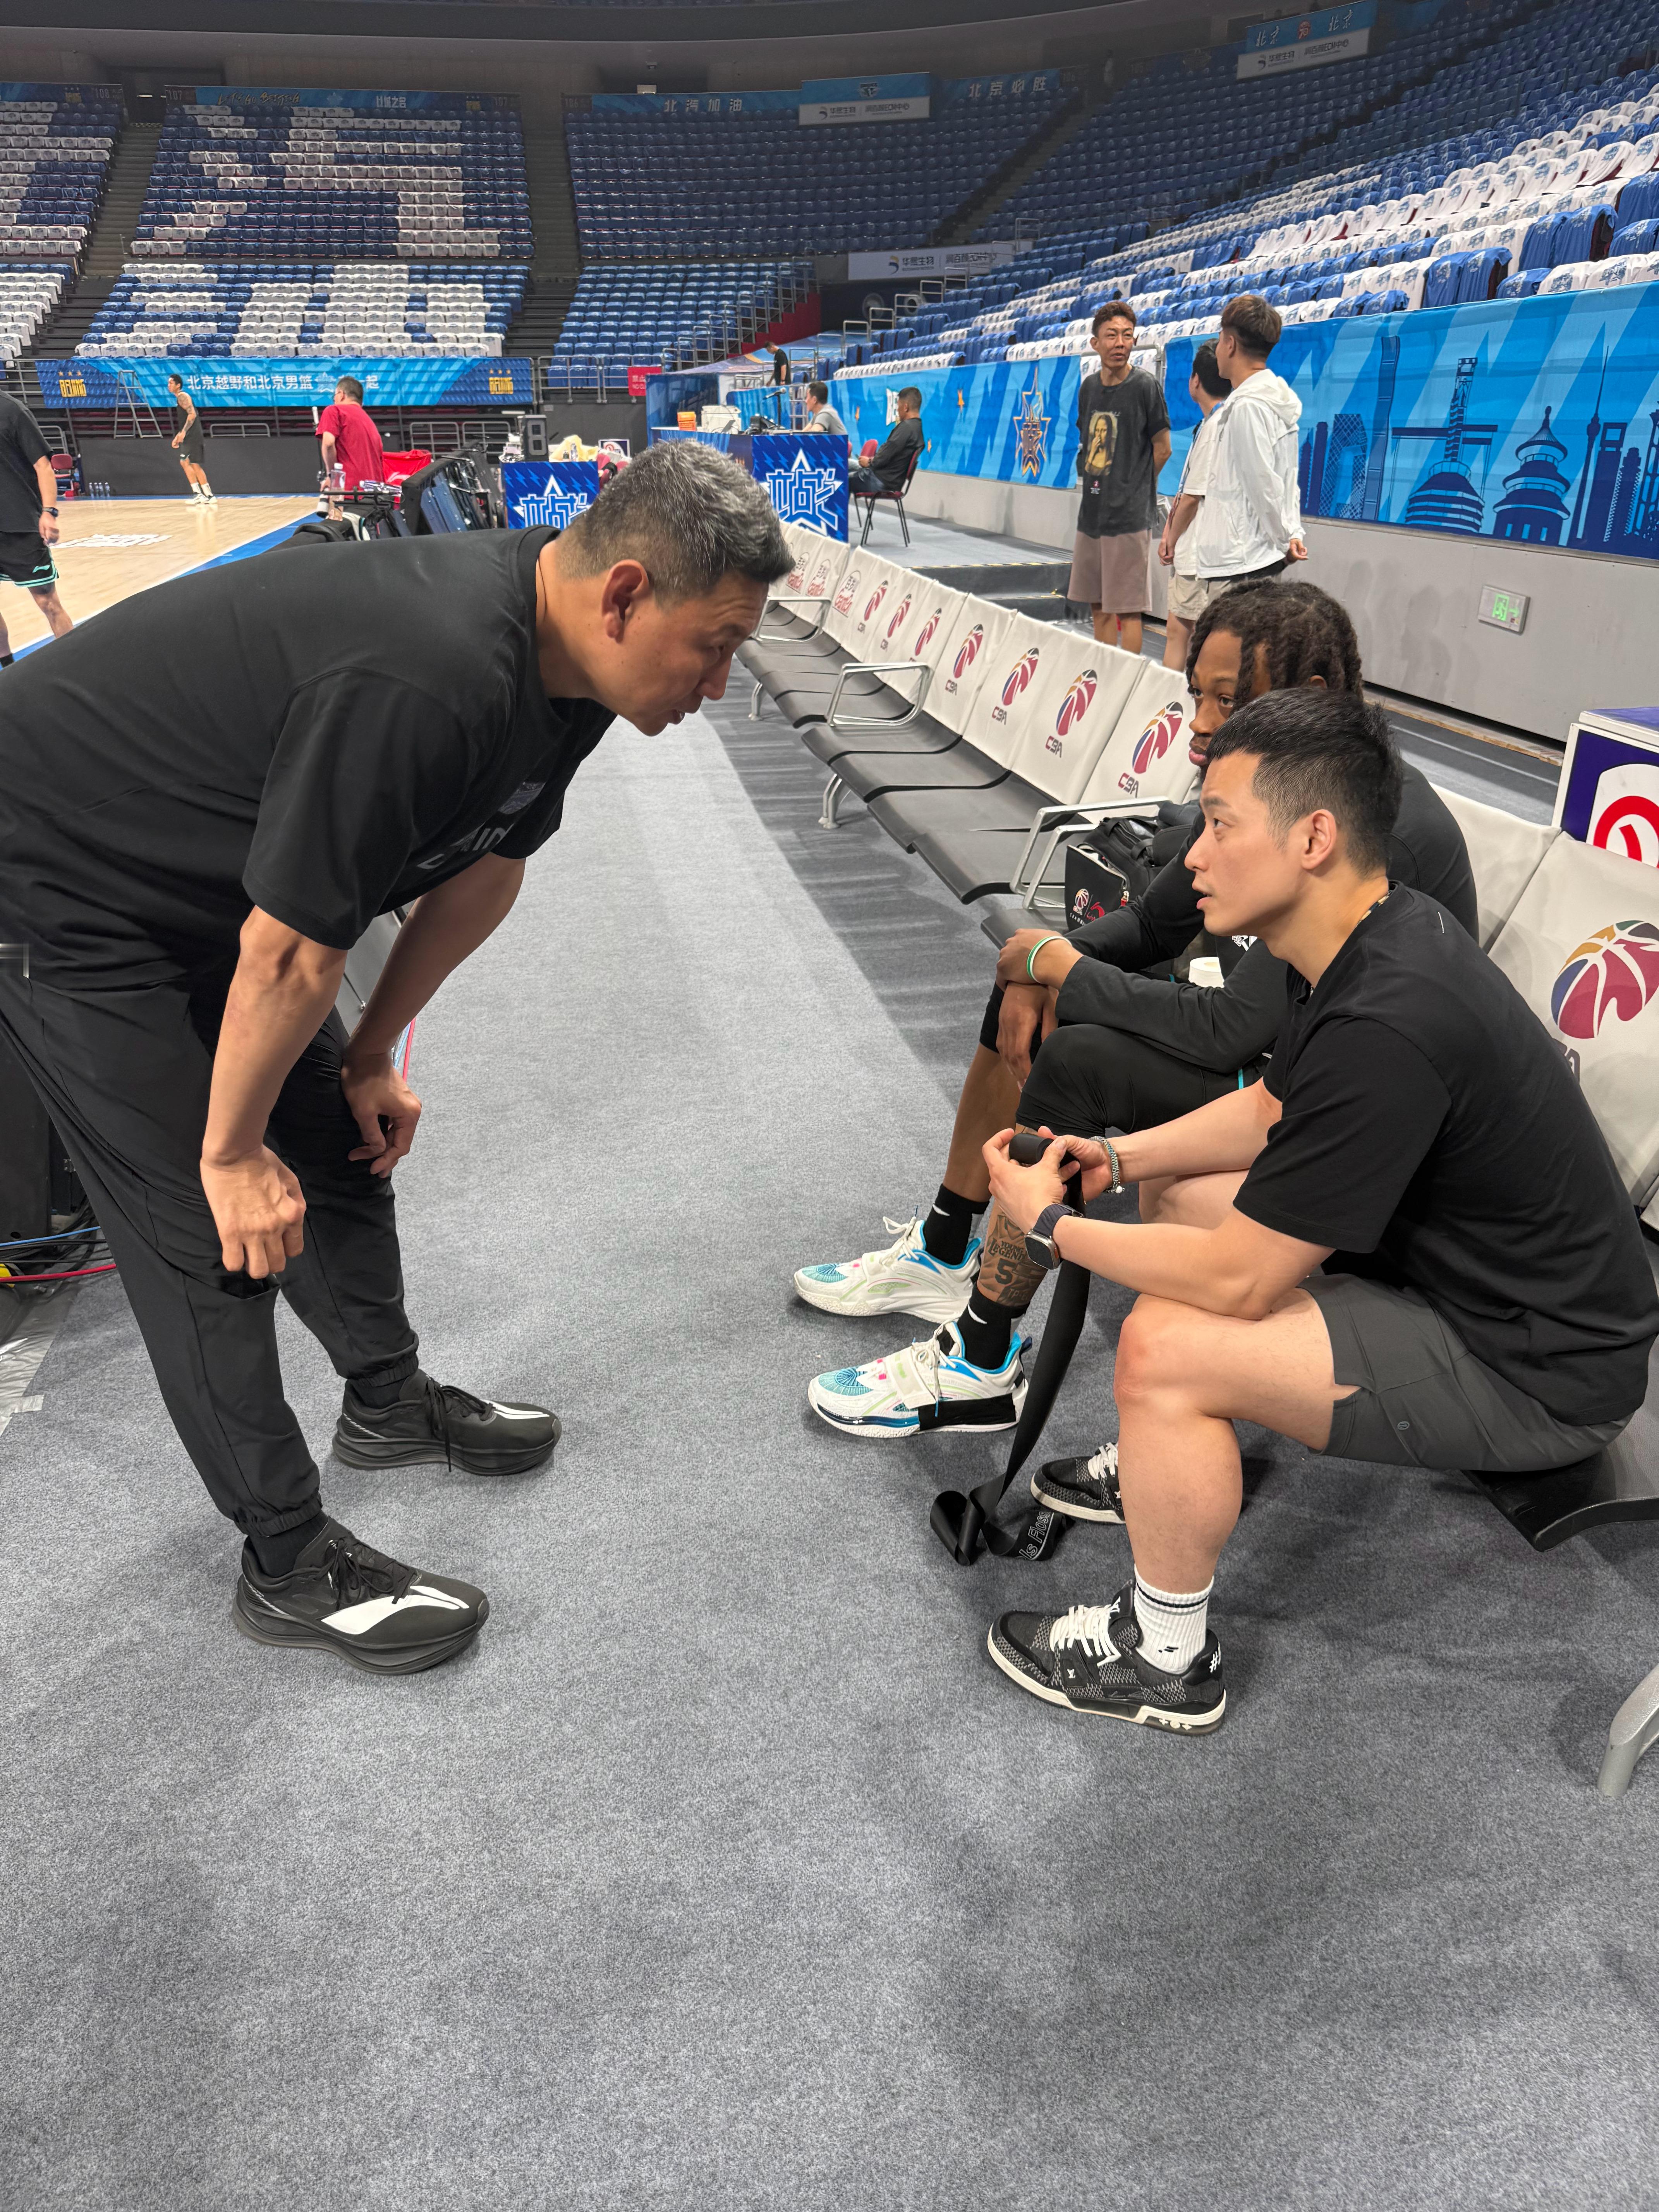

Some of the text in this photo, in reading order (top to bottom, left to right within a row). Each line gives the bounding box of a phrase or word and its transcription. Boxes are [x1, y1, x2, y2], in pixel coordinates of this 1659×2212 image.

[969, 76, 1047, 97] 北京必胜
[664, 98, 742, 112] 北汽加油
[187, 375, 314, 390] 北京越野和北京男篮
[945, 679, 958, 696] CBA
[991, 706, 1008, 726] CBA
[1045, 735, 1062, 758] CBA
[1118, 772, 1139, 798] CBA
[994, 1257, 1016, 1285] 5
